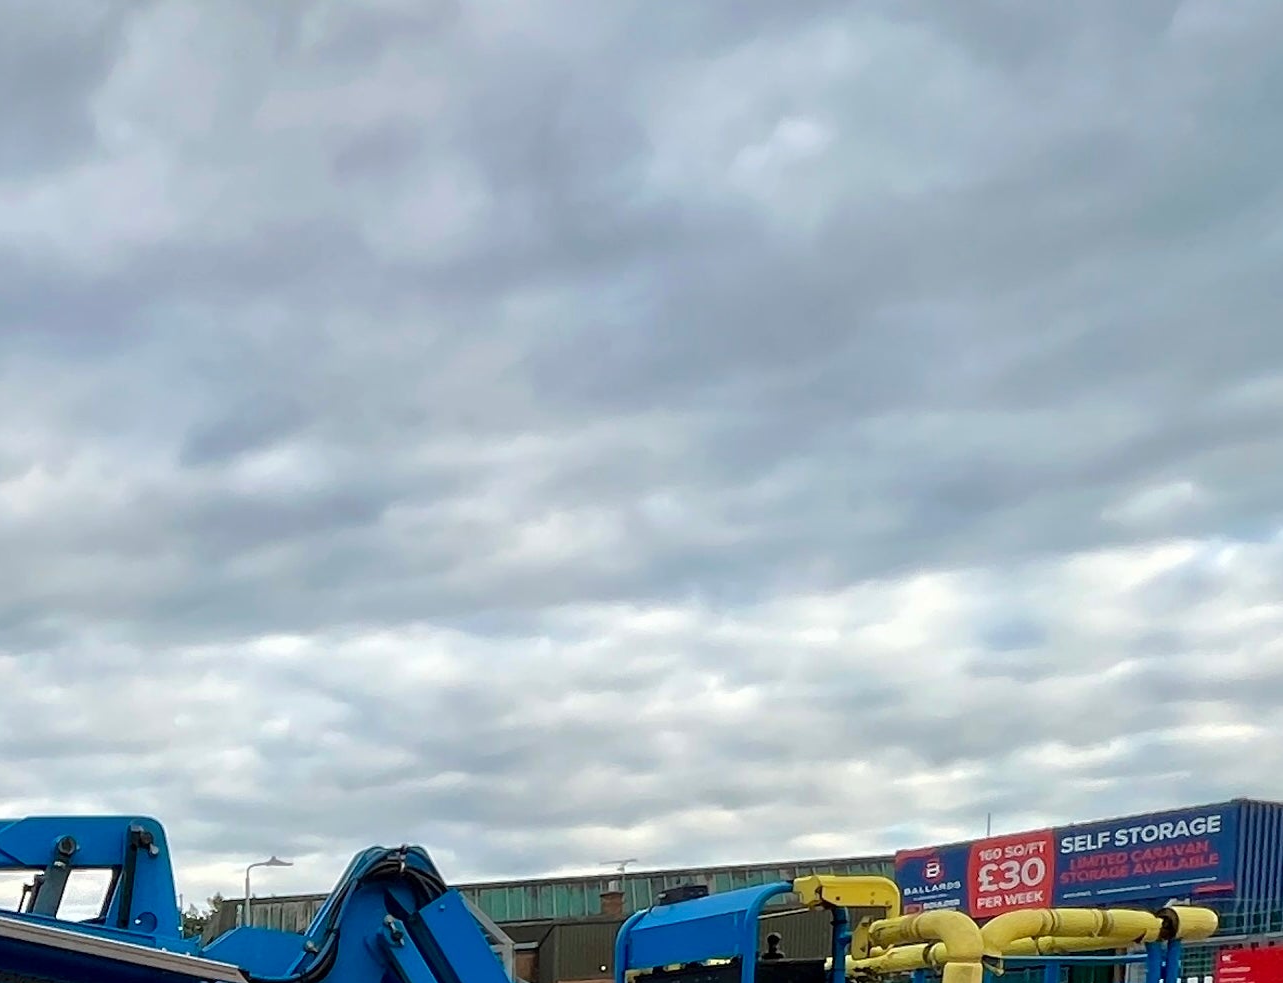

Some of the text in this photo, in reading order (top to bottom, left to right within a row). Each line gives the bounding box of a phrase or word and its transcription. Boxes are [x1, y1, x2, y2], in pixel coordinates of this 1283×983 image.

[1060, 815, 1221, 854] SELF STORAGE
[1059, 853, 1220, 884] STORAGE AVAILABLE
[1070, 840, 1210, 871] LIMITED CARAVAN
[904, 880, 961, 896] BALLARDS
[977, 857, 1046, 892] £30
[976, 890, 1044, 909] PER WEEK
